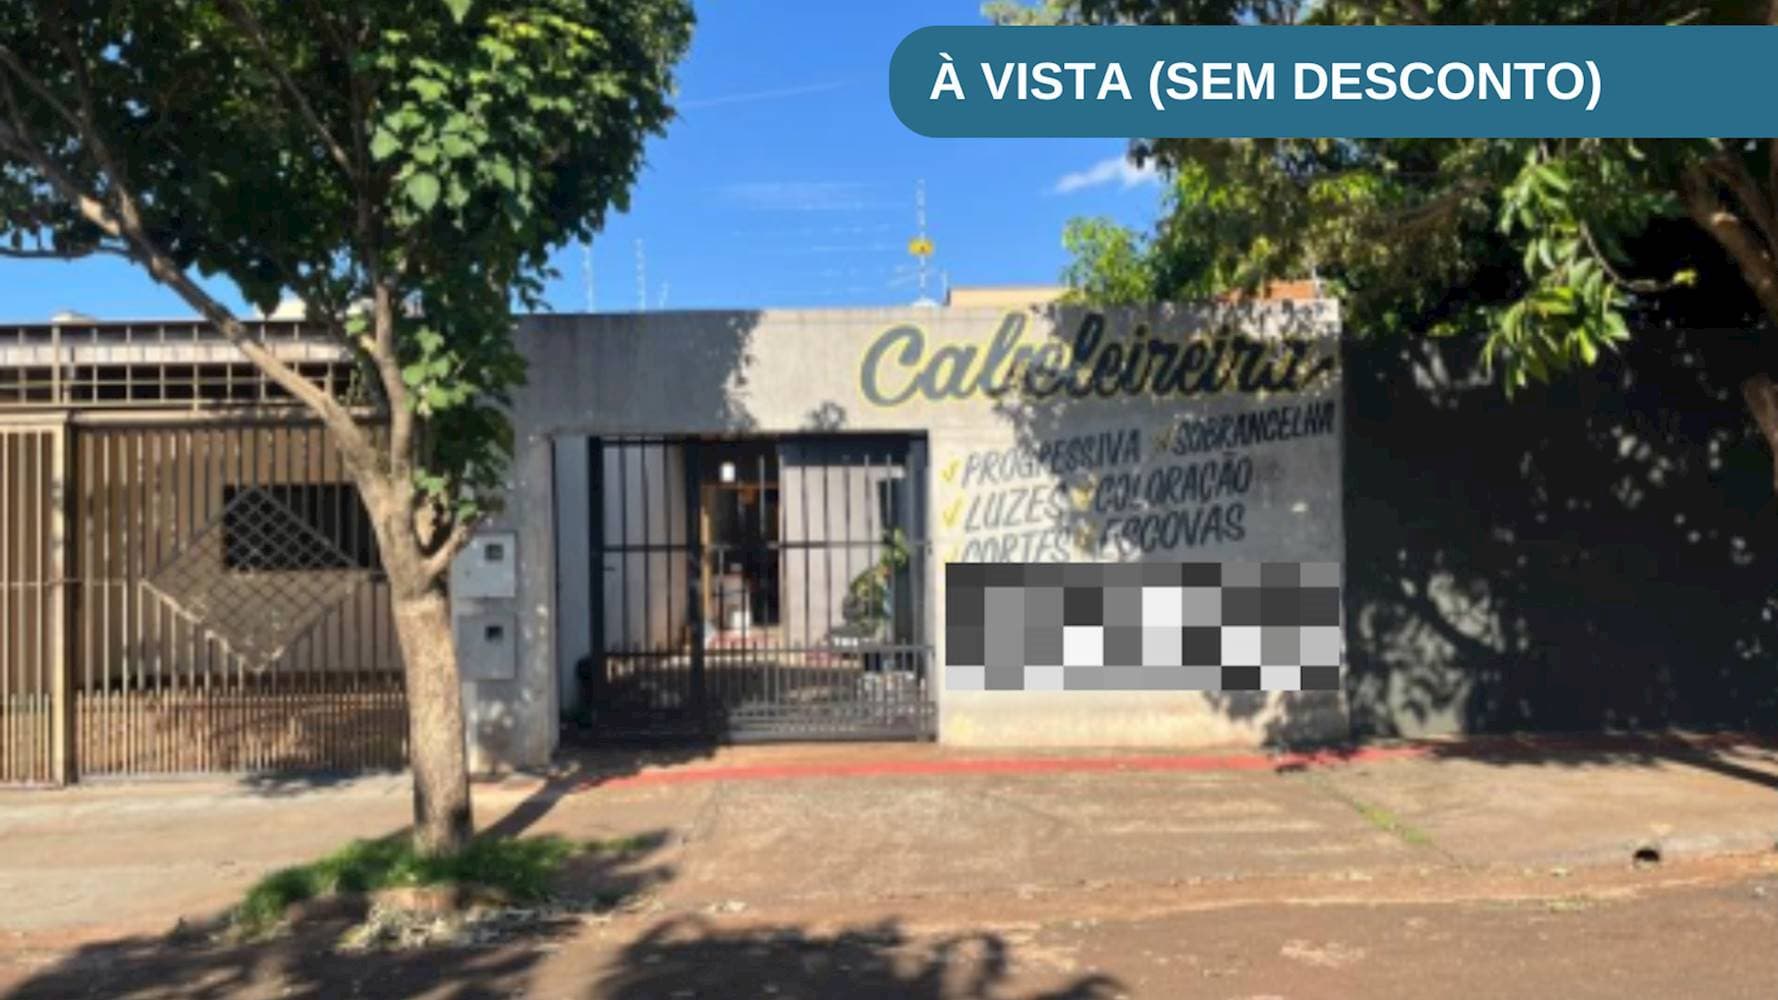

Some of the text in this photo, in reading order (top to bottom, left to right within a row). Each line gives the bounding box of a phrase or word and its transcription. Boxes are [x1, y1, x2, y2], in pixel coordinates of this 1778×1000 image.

[861, 312, 1336, 407] Cabeleireira
[962, 402, 1336, 488] PROGRESSIVA SOBRANCELHA
[965, 451, 1253, 531] LUZES COLORAÇÃO
[1100, 503, 1247, 552] ESCOVAS
